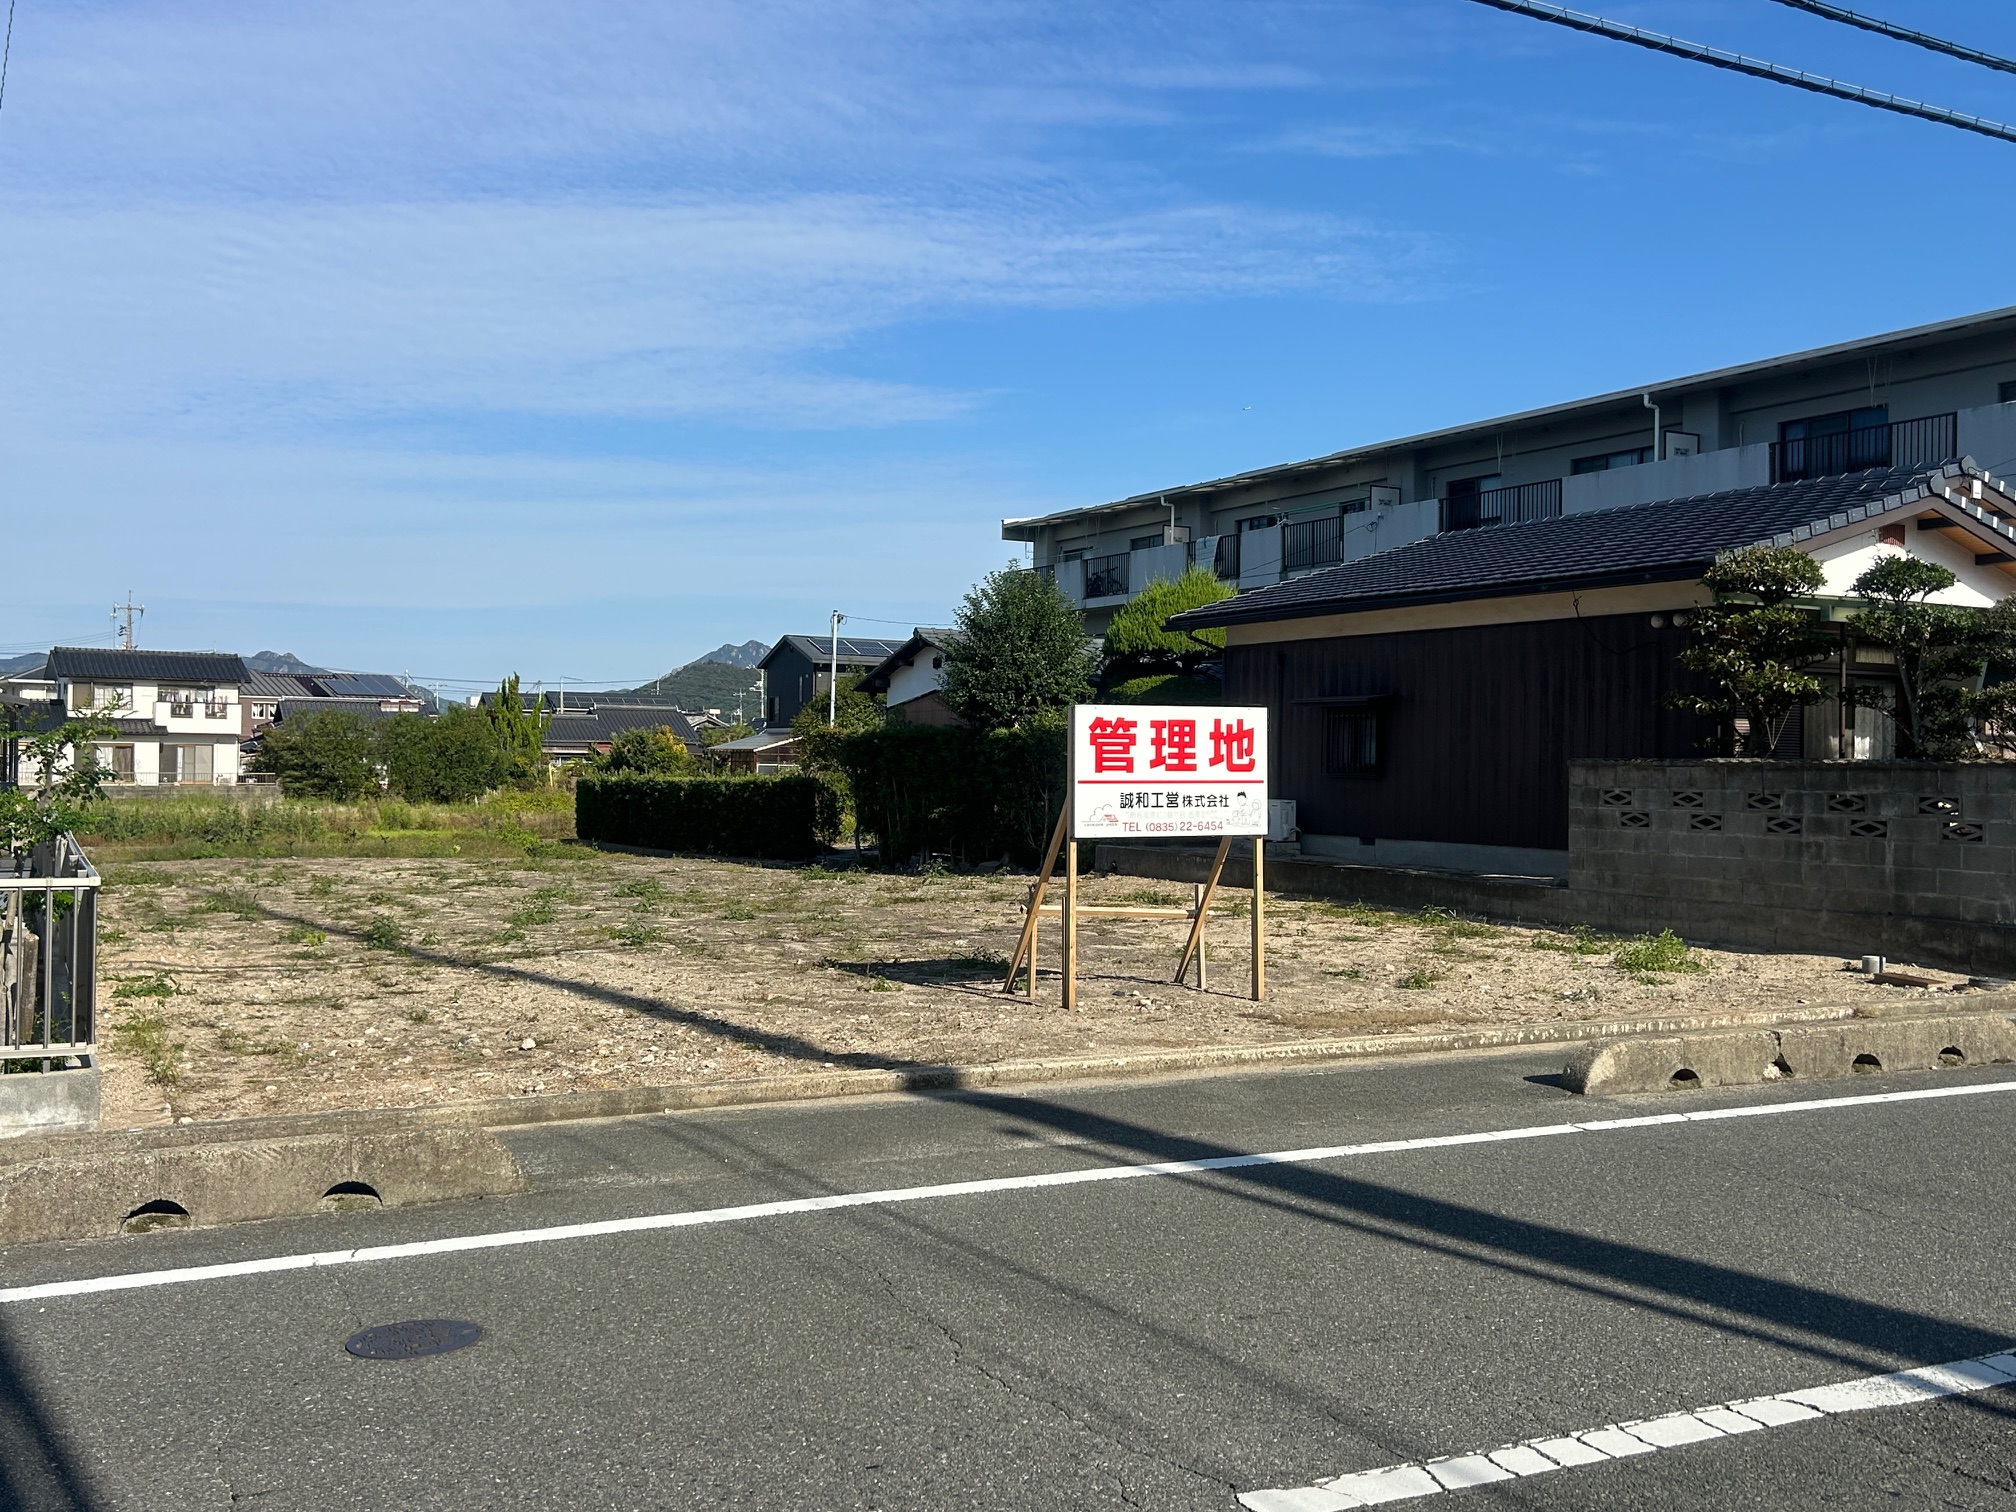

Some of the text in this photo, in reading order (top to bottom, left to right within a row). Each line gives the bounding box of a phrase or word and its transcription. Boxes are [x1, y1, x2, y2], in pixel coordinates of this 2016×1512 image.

[1088, 716, 1256, 773] 管理地
[1122, 822, 1142, 832] TEL
